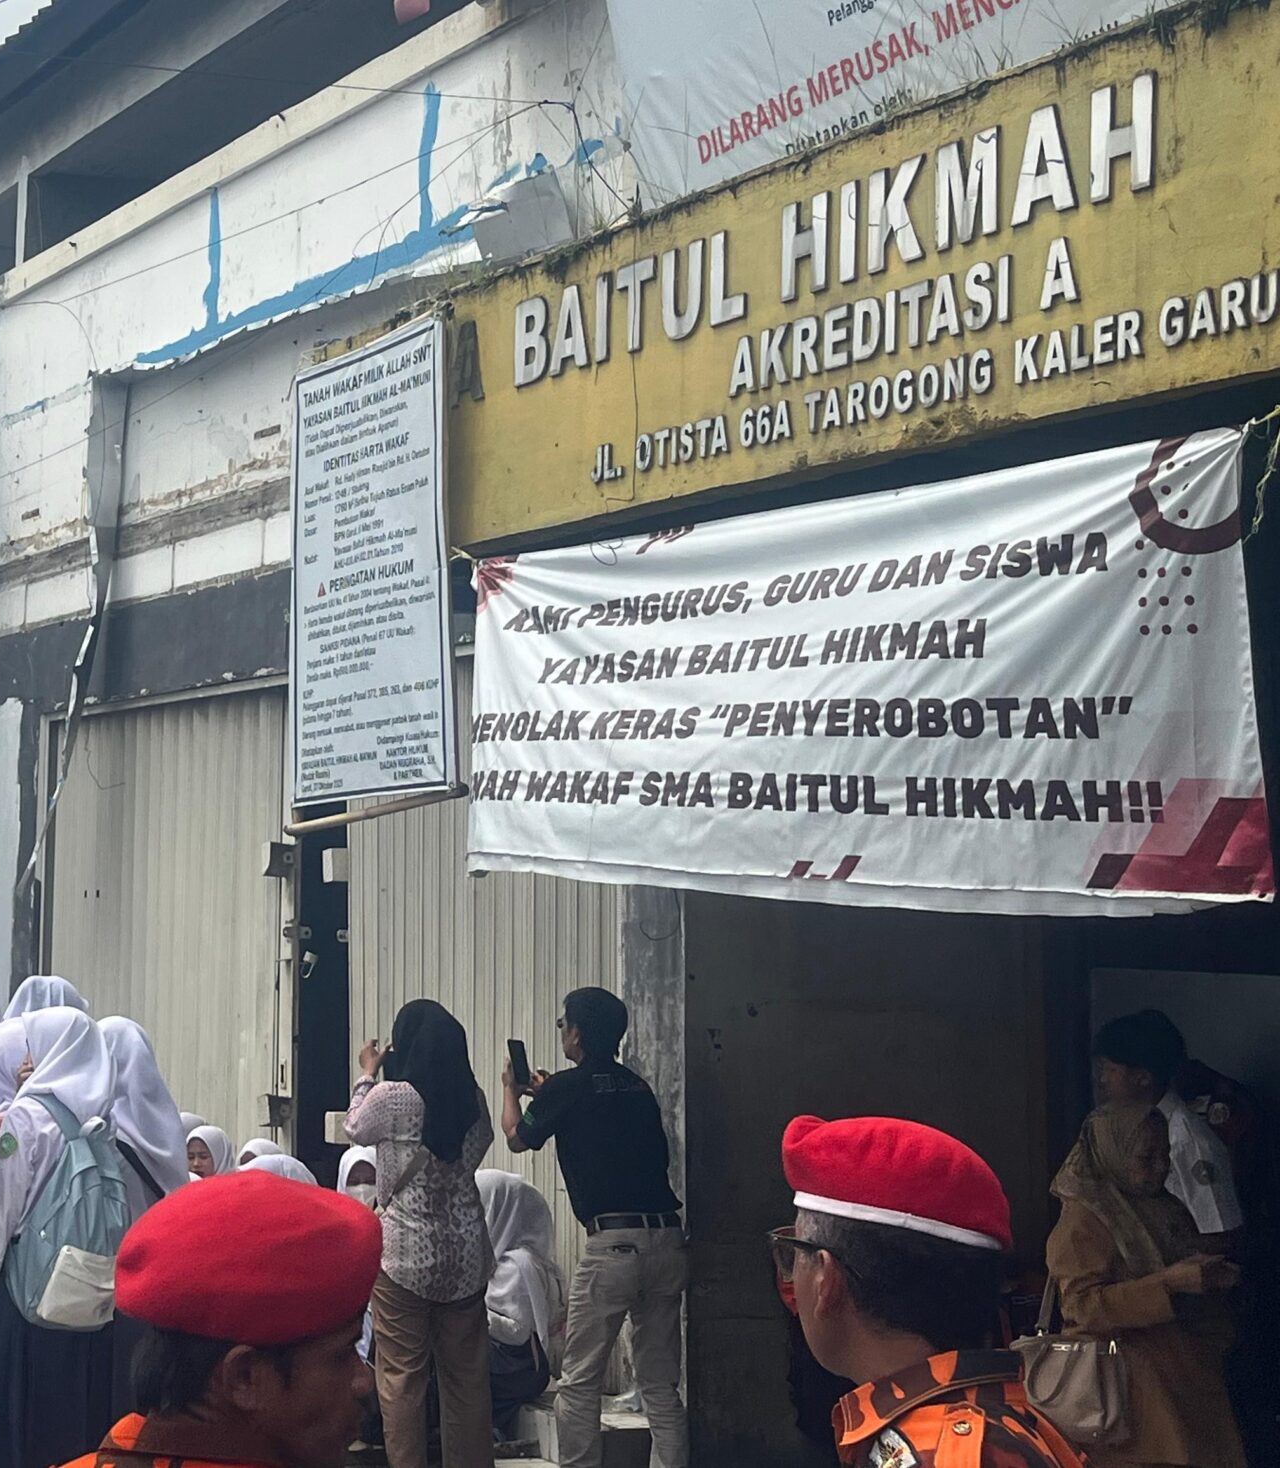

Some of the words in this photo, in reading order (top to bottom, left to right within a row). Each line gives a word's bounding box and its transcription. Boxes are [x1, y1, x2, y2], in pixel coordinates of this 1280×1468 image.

[697, 85, 804, 164] DILARANG
[807, 21, 930, 108] MERUSAK,
[513, 230, 748, 389] BAITUL
[780, 69, 1158, 304] HIKMAH
[728, 254, 1013, 398] AKREDITASI
[1040, 236, 1080, 311] A
[303, 383, 331, 410] TANAH
[332, 370, 363, 399] WAKAF
[363, 361, 384, 386] MILIK
[385, 351, 411, 377] ALLAH
[412, 342, 431, 366] SWT
[590, 442, 625, 484] JL.
[635, 415, 731, 472] OTISTA
[739, 399, 793, 449] 66A
[804, 348, 993, 434] TAROGONG
[1014, 309, 1144, 385] KALER
[303, 407, 332, 432] YAYASAN
[333, 396, 360, 420] BAITUL
[323, 448, 359, 474] IDENTITAS
[384, 430, 410, 452] WAKAF
[377, 557, 414, 581] HUKUM
[577, 580, 753, 629] PENGURUS,
[763, 562, 868, 607] GURU
[867, 549, 955, 593] DAN
[960, 532, 1108, 581] SISWA
[537, 646, 682, 685] YAYASAN
[684, 633, 809, 676] BAITUL
[820, 618, 987, 665] HIKMAH
[589, 706, 701, 740] KERAS
[471, 770, 522, 802] NAH
[524, 770, 634, 805] WAKAF
[639, 771, 715, 808] SMA
[727, 773, 889, 815] BAITUL
[905, 776, 1164, 823] HIKMAH!!
